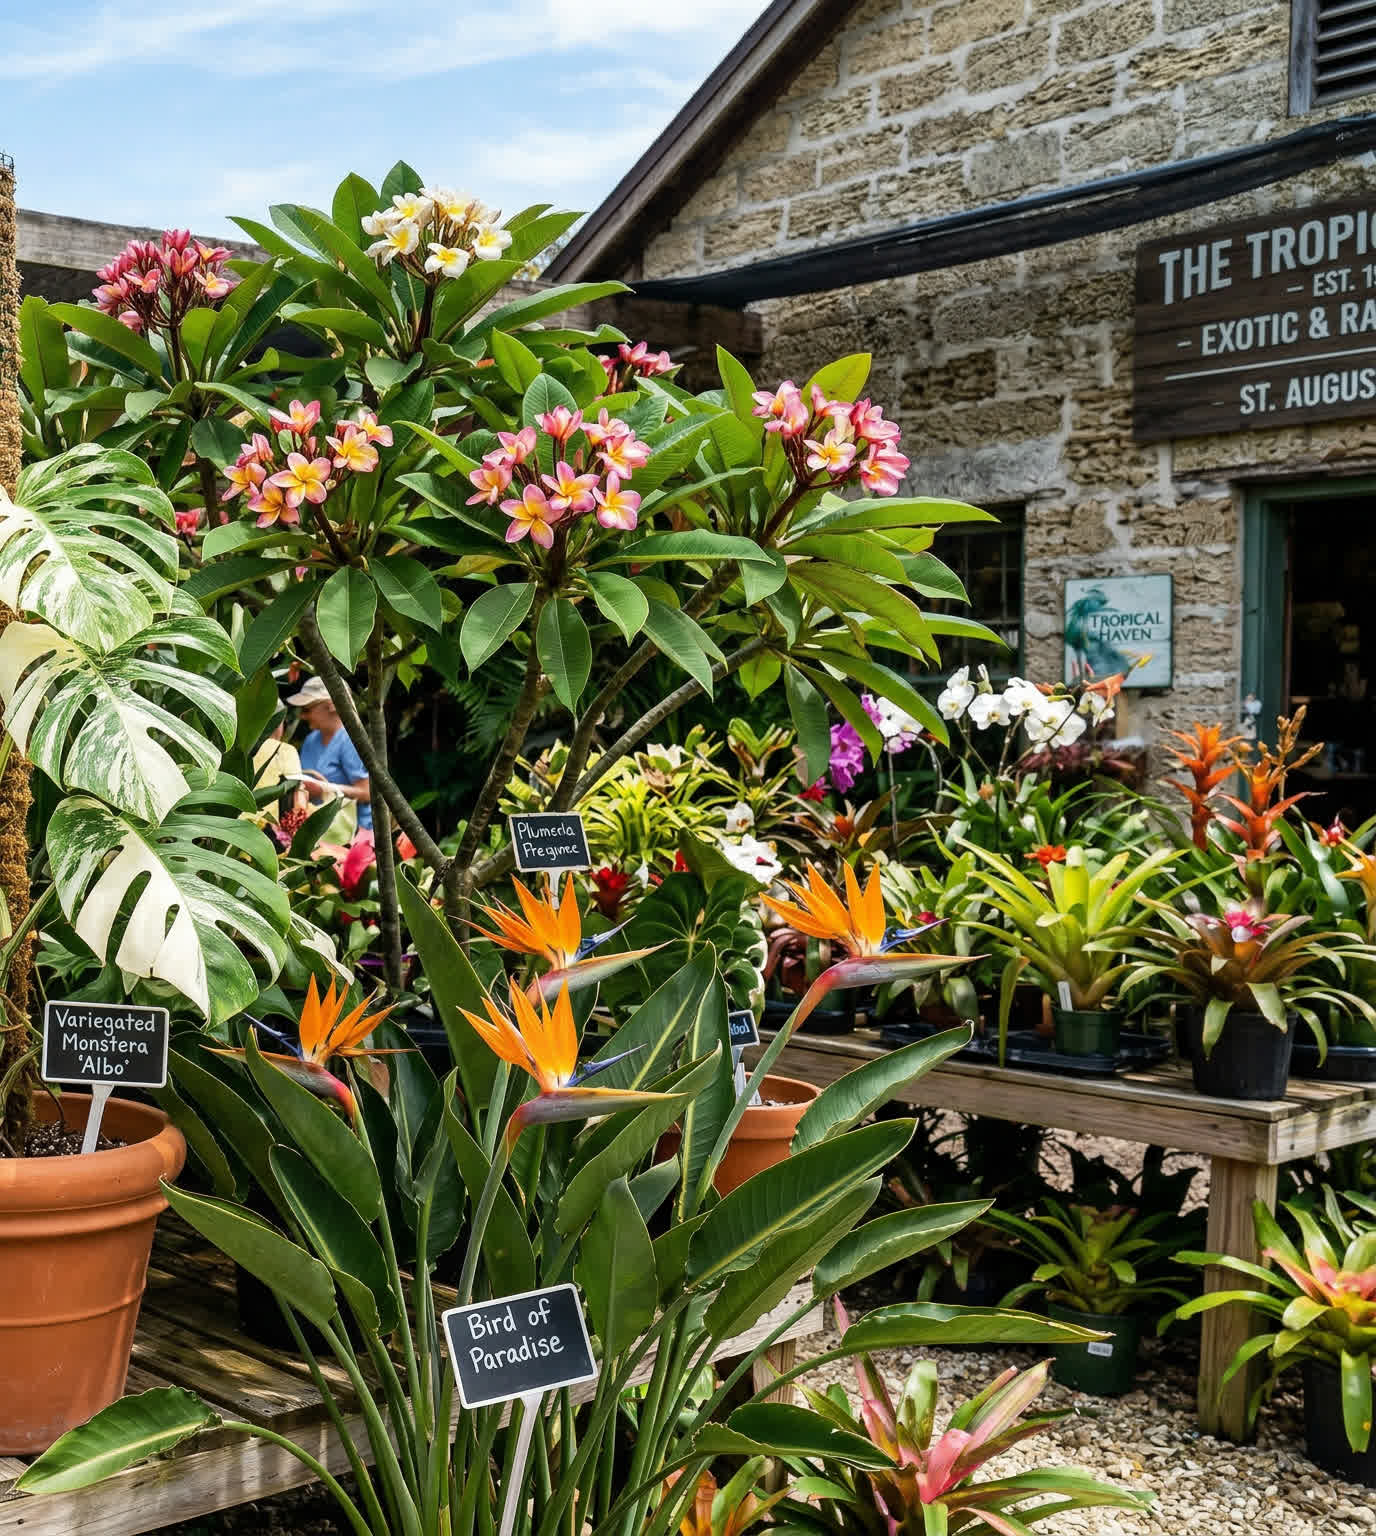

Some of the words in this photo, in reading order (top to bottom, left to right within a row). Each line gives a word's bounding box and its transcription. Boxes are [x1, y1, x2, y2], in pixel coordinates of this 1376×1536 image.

[1158, 238, 1233, 305] THE
[1246, 210, 1376, 280] TROPI
[1312, 267, 1356, 297] EST.
[1361, 263, 1376, 289] 1
[1201, 310, 1300, 356] EXOTIC
[1308, 306, 1331, 340] &
[1239, 381, 1277, 414] ST.
[1284, 367, 1376, 409] AUGUS
[1090, 610, 1164, 629] TROPICAL
[1099, 627, 1153, 642] HAVEN
[55, 1008, 156, 1036] Variegated
[62, 1032, 149, 1055] Monstera
[466, 1305, 518, 1340] Bird
[527, 1297, 551, 1326] of
[468, 1335, 565, 1374] Paradise
